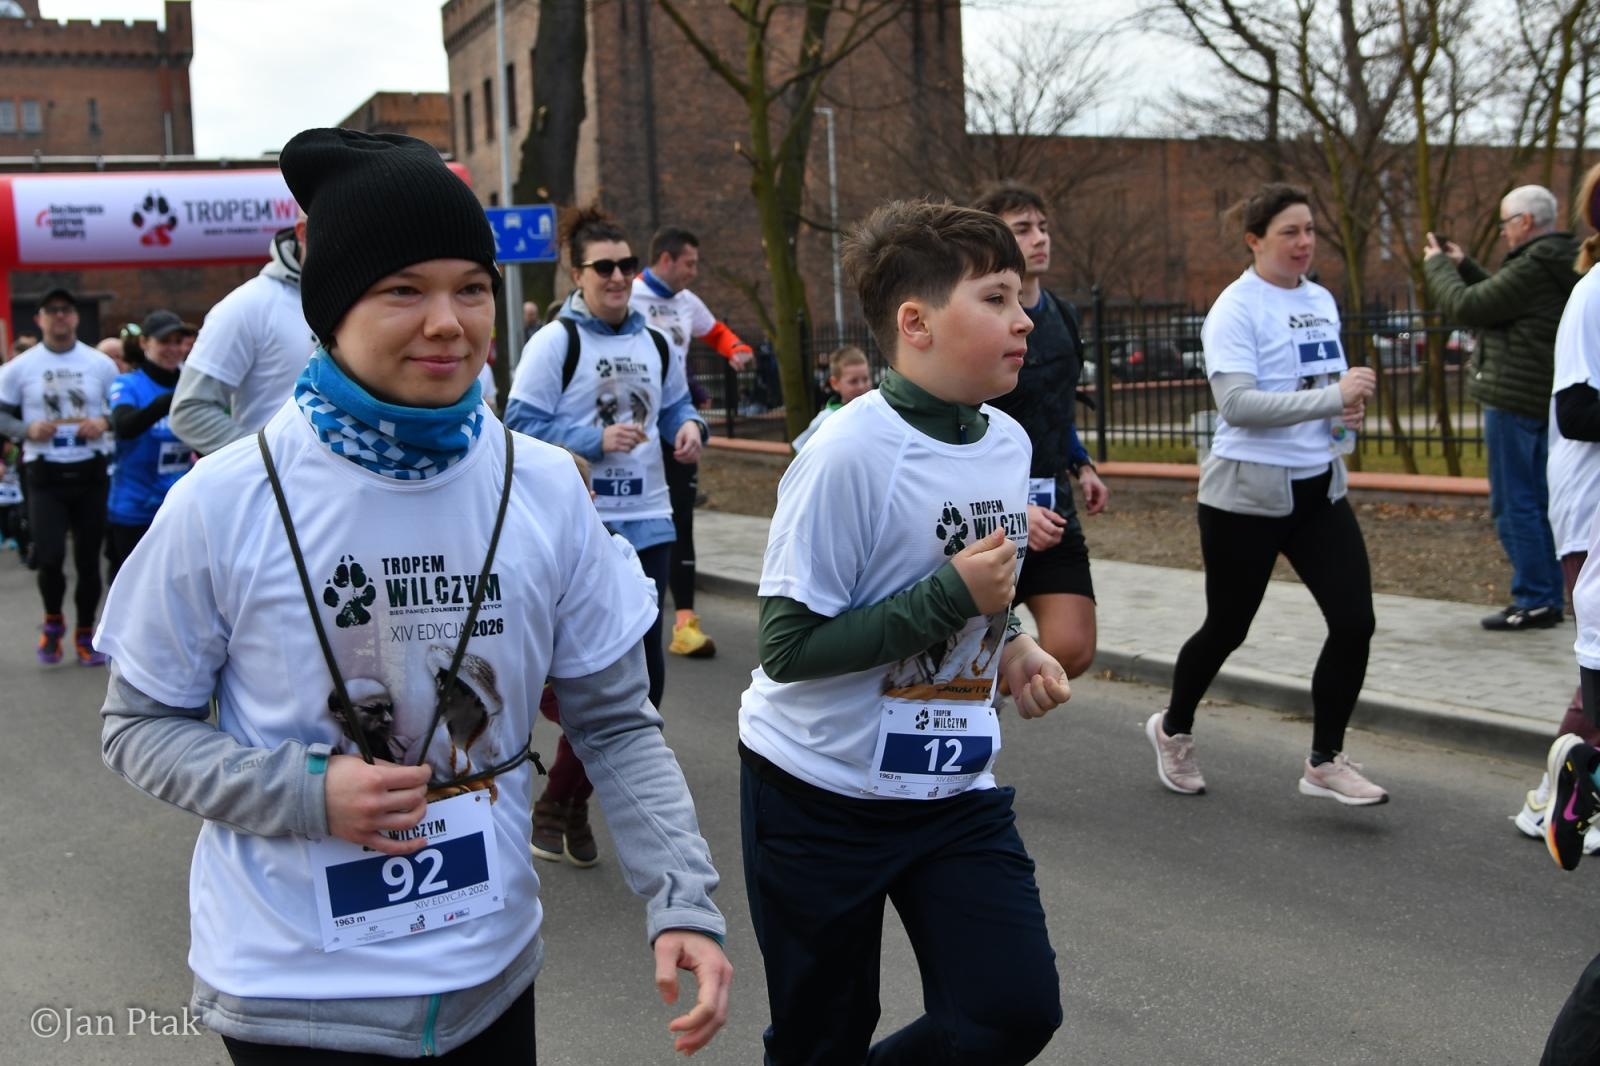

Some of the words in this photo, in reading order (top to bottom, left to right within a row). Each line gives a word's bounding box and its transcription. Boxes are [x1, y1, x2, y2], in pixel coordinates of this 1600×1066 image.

[1317, 343, 1327, 359] 4
[610, 481, 632, 496] 16
[969, 499, 1005, 516] TROPEM
[382, 555, 445, 575] TROPEM
[385, 573, 502, 608] WILCZYM
[390, 623, 414, 642] XIV
[471, 618, 504, 637] 2026
[933, 717, 968, 729] WILCZYM
[924, 738, 963, 772] 12
[388, 819, 446, 840] WILCZYM
[381, 848, 449, 903] 92
[413, 899, 430, 910] XIV
[468, 882, 489, 897] 2026
[334, 915, 355, 928] 1963
[356, 914, 366, 924] m
